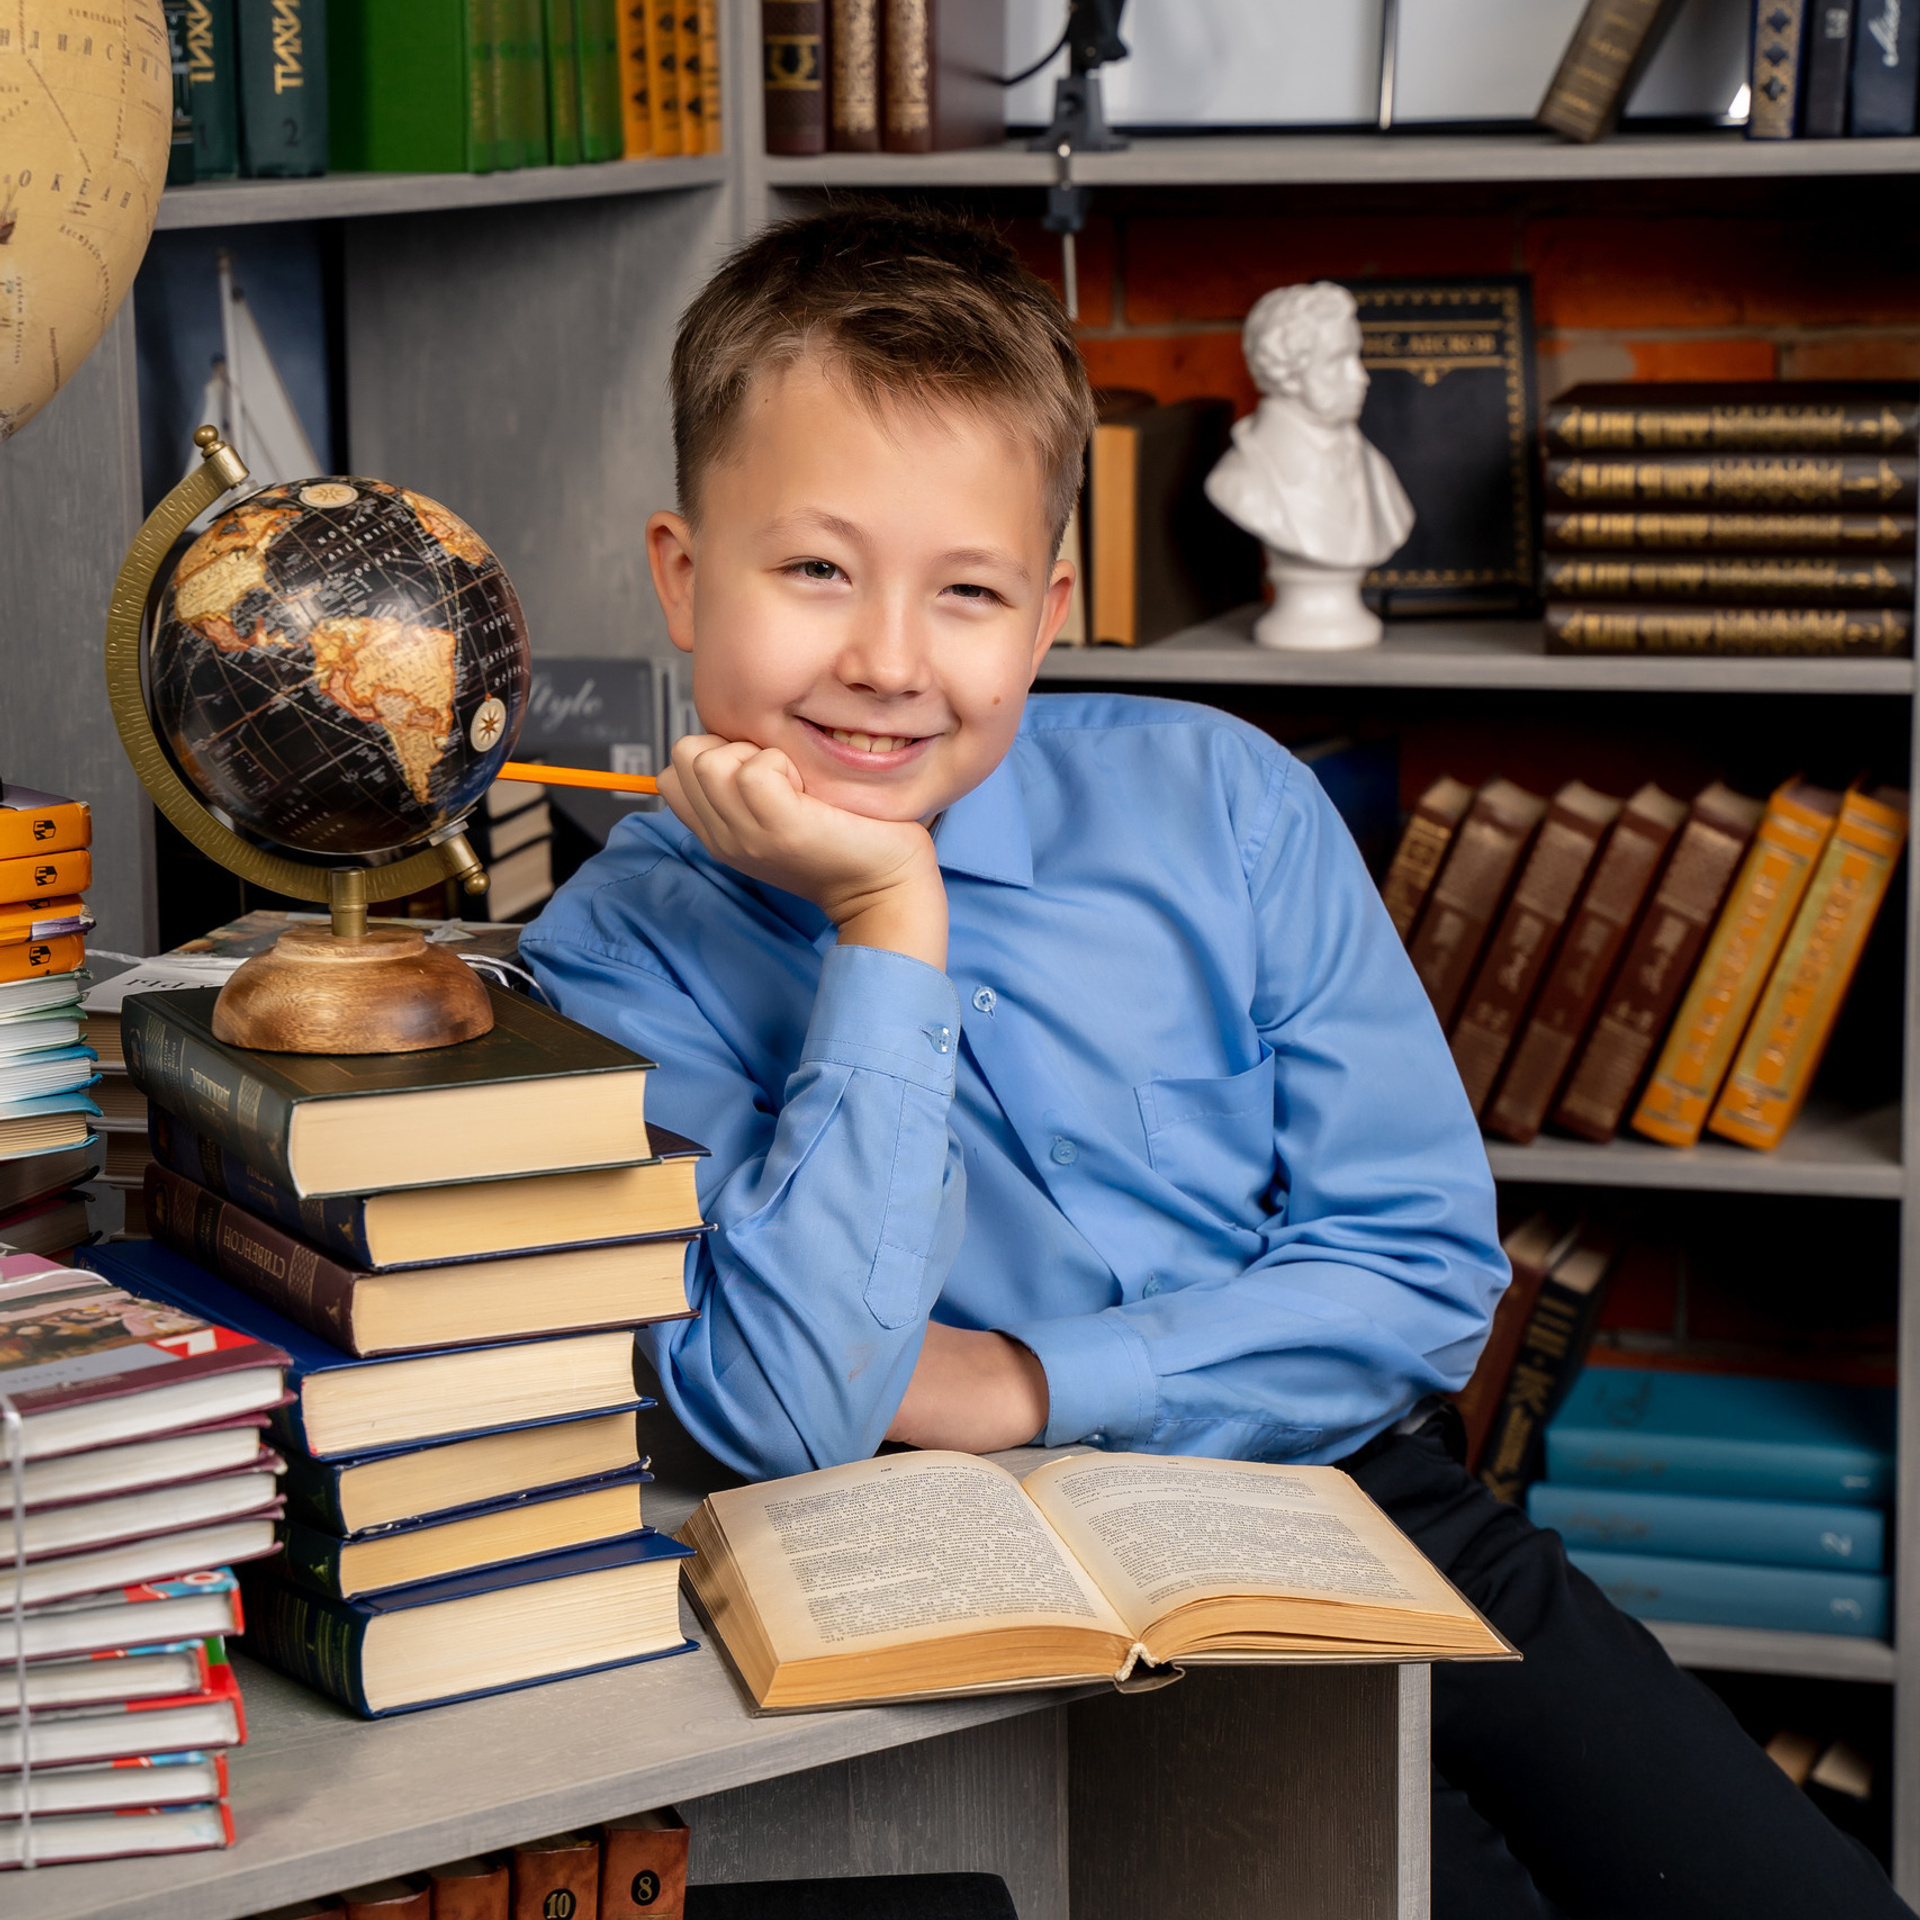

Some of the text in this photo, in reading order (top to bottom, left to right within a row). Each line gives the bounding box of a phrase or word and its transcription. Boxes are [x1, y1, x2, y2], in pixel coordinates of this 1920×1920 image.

[283, 117, 300, 147] 2
[19, 169, 131, 209] ОКЕАН
[318, 515, 367, 545] NORTH
[328, 520, 396, 561] ATLANTIC
[354, 548, 401, 577] OCEAN
[223, 1225, 286, 1280] СТИВЕНСОН
[1820, 1531, 1853, 1557] 2
[1829, 1597, 1863, 1621] 3
[637, 1875, 654, 1901] 8
[545, 1892, 572, 1920] 10
